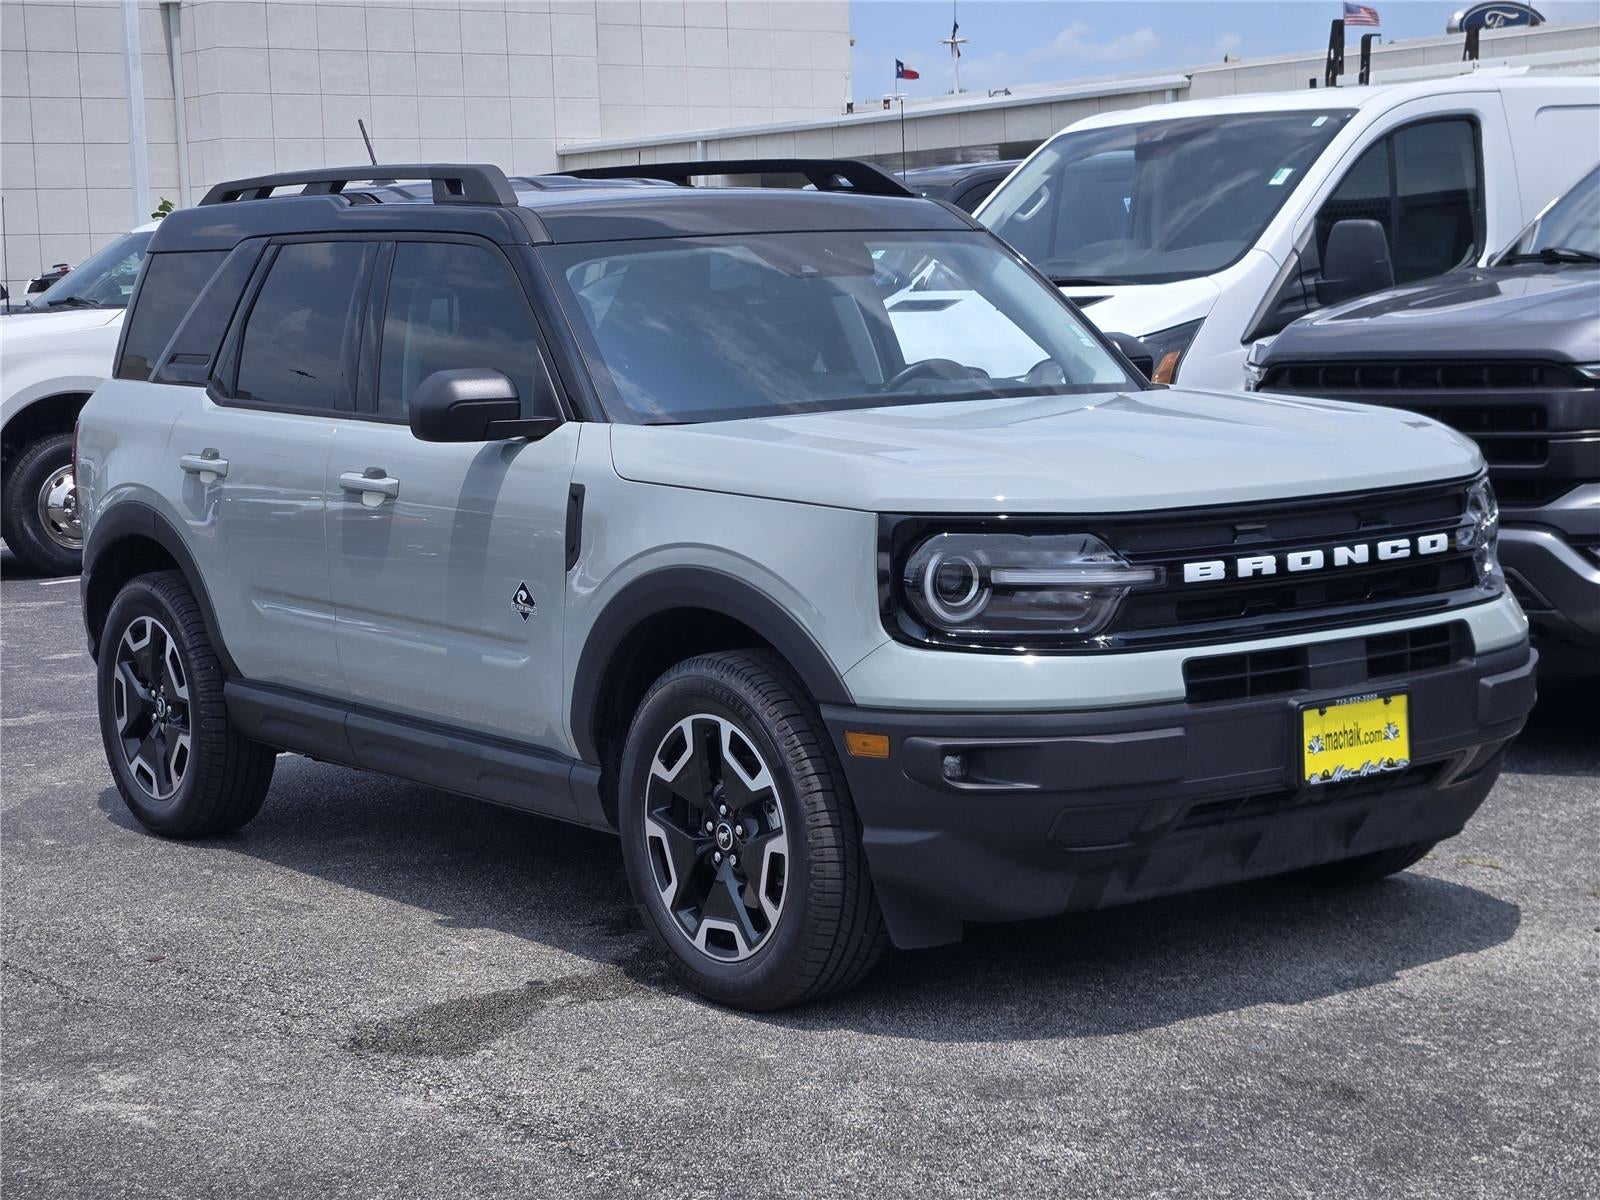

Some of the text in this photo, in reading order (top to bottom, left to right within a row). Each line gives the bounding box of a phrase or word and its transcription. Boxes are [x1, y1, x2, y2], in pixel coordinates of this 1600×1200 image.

[1184, 533, 1449, 583] BRONCO
[1325, 721, 1382, 752] machaik.com
[1332, 764, 1358, 782] Mac
